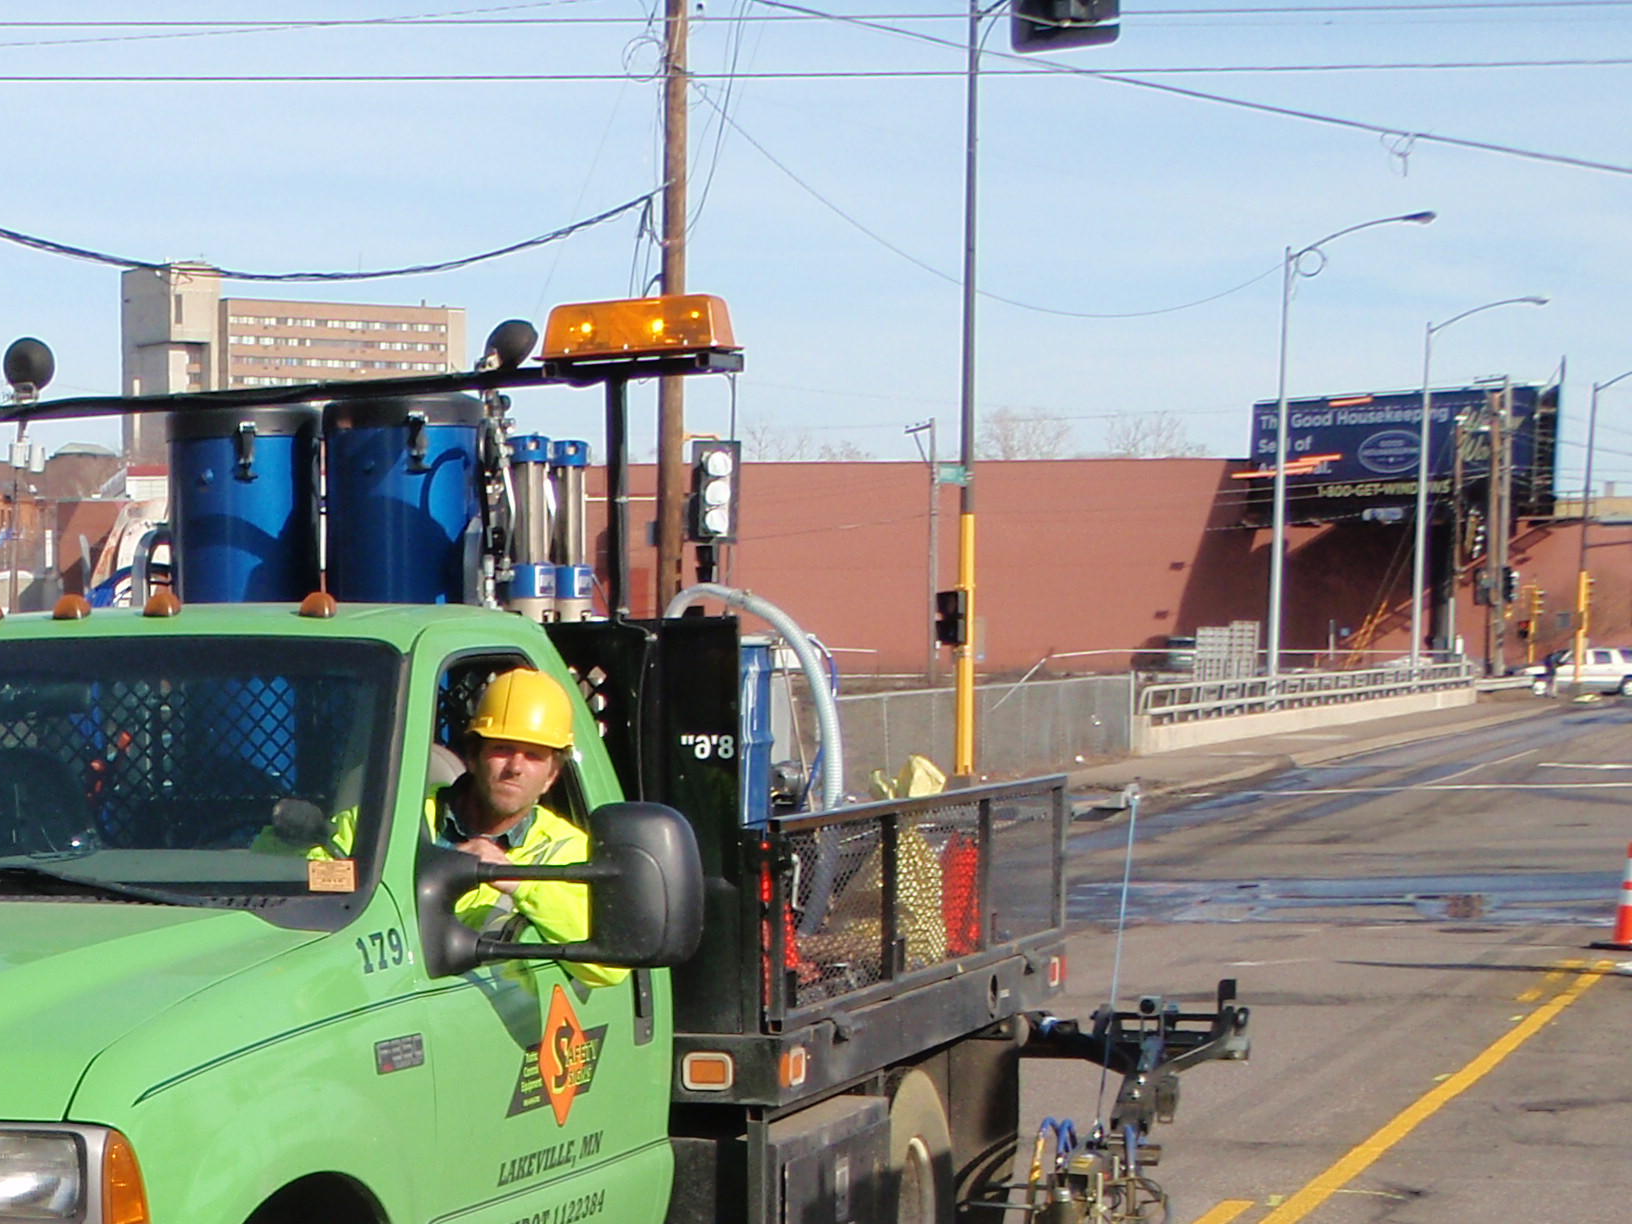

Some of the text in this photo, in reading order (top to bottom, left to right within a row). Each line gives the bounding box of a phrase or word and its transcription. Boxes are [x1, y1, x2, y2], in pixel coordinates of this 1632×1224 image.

[1261, 414, 1280, 430] Th
[1290, 411, 1332, 428] Good
[1336, 406, 1449, 425] Housekeepng
[1257, 436, 1313, 454] Sel of
[1318, 478, 1451, 498] 1-800-GET-WINDWS
[356, 928, 404, 974] 179
[497, 1130, 603, 1188] LAKEVILLE, MN
